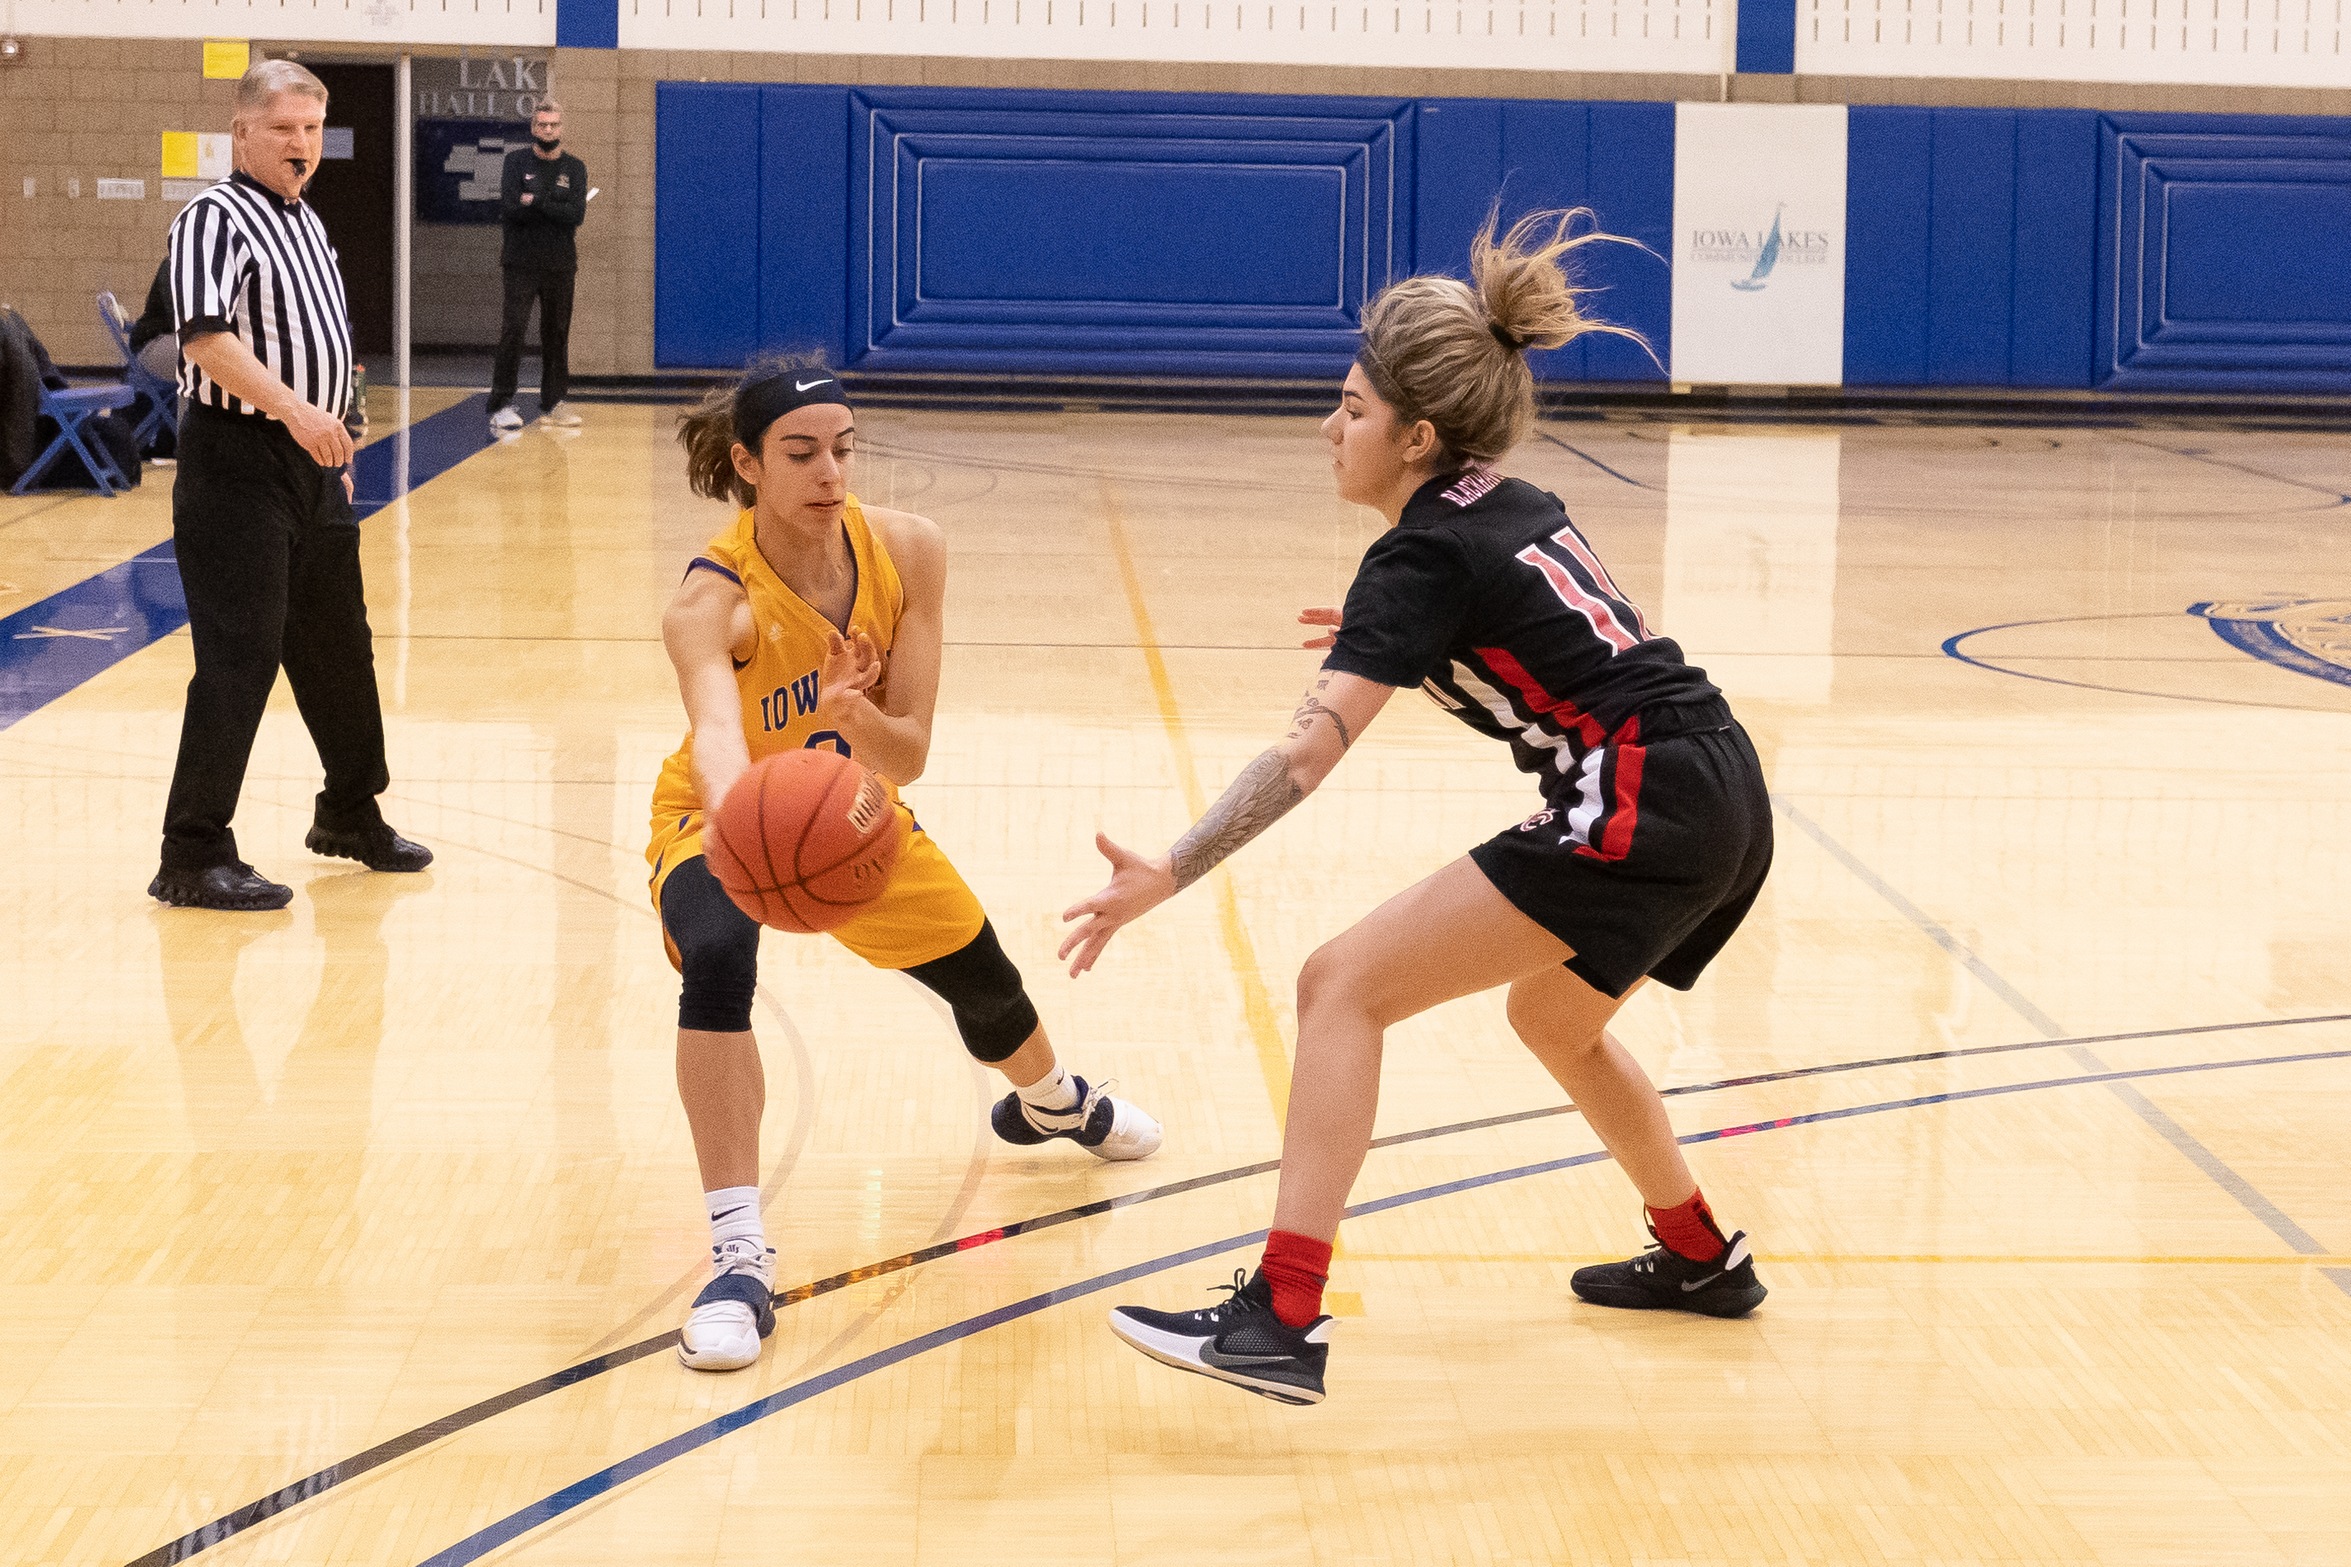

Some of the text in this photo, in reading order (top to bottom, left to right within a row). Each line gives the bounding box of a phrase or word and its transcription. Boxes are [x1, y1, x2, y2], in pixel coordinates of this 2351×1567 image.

[1692, 230, 1750, 248] IOWA
[1514, 525, 1663, 658] 11
[760, 668, 820, 733] IOW
